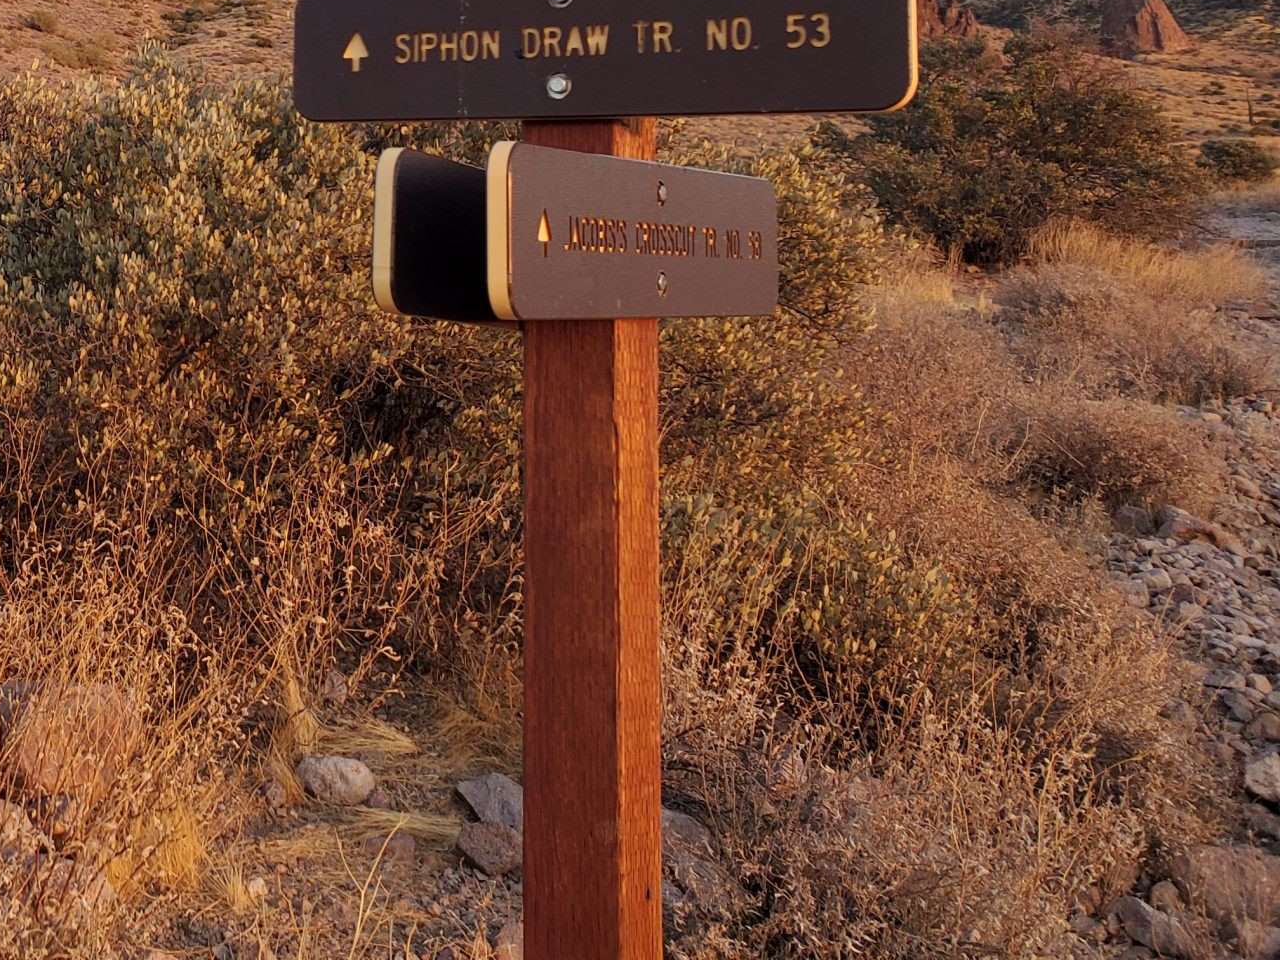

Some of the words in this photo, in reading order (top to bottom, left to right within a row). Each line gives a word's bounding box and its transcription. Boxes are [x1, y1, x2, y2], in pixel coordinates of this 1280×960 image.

[394, 31, 500, 64] SIPHON
[522, 25, 609, 59] DRAW
[632, 20, 681, 53] TR.
[706, 17, 759, 51] NO.
[786, 13, 832, 49] 53
[635, 222, 696, 257] CROSSCUT
[702, 226, 720, 258] TR.
[724, 229, 743, 259] NO.
